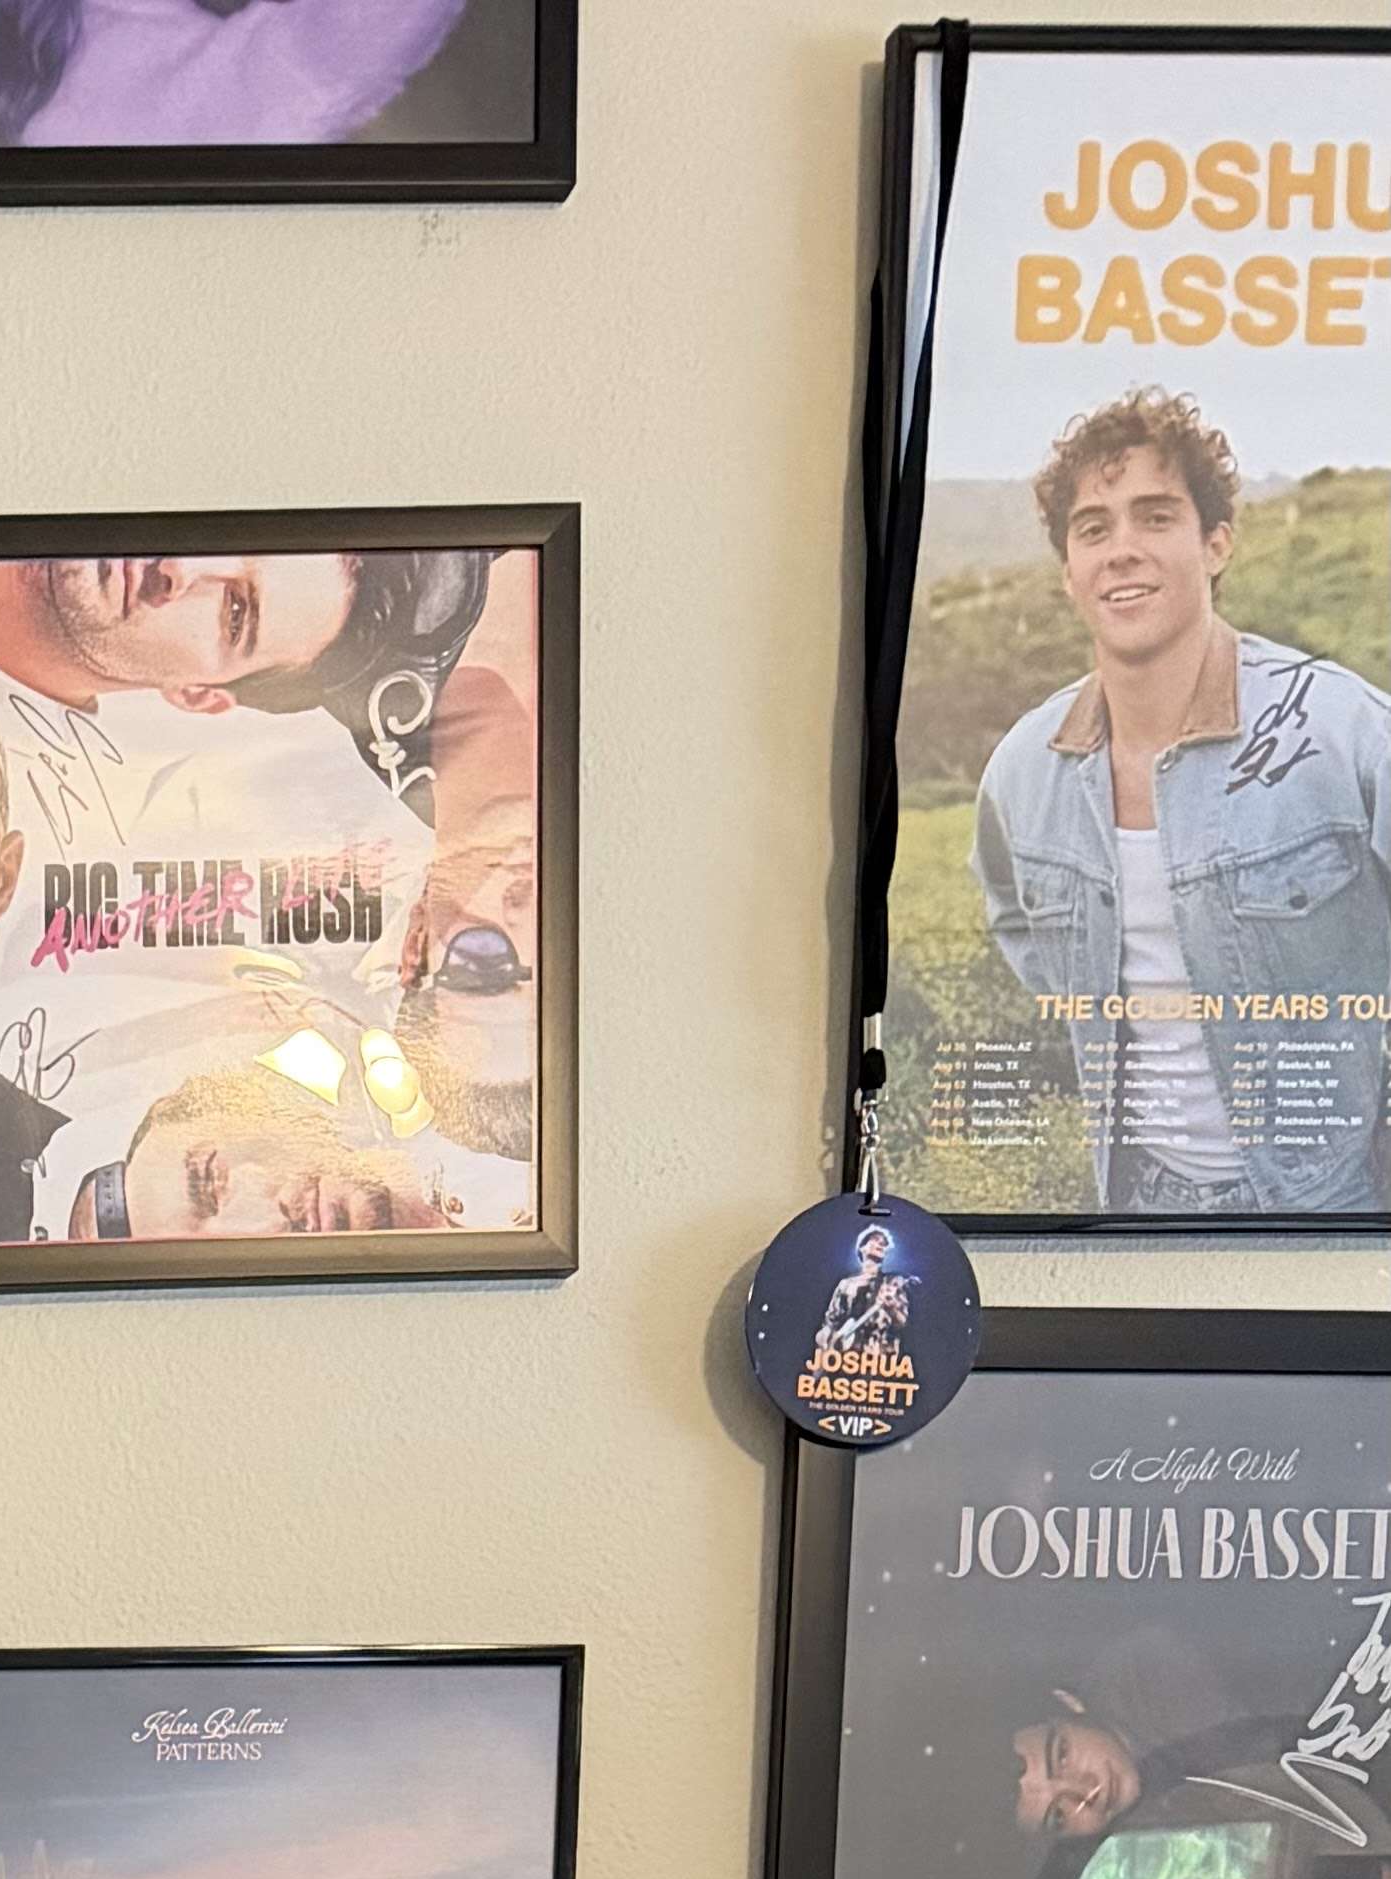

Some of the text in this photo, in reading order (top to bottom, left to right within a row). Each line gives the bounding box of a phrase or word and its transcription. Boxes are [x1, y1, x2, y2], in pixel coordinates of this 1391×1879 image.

[1014, 253, 1391, 347] BASSE
[31, 867, 260, 974] ANOTHER
[44, 857, 384, 949] BIG TIME RUSH
[1036, 994, 1329, 1022] THE GOLDEN YEARS
[805, 1349, 915, 1379] JOSHUA
[797, 1374, 920, 1407] BASSETT
[1090, 1446, 1301, 1494] A Night With
[946, 1505, 1184, 1580] JOSHUA
[131, 1706, 289, 1742] Kelsea Ballerini
[155, 1742, 263, 1763] PATTERNS
